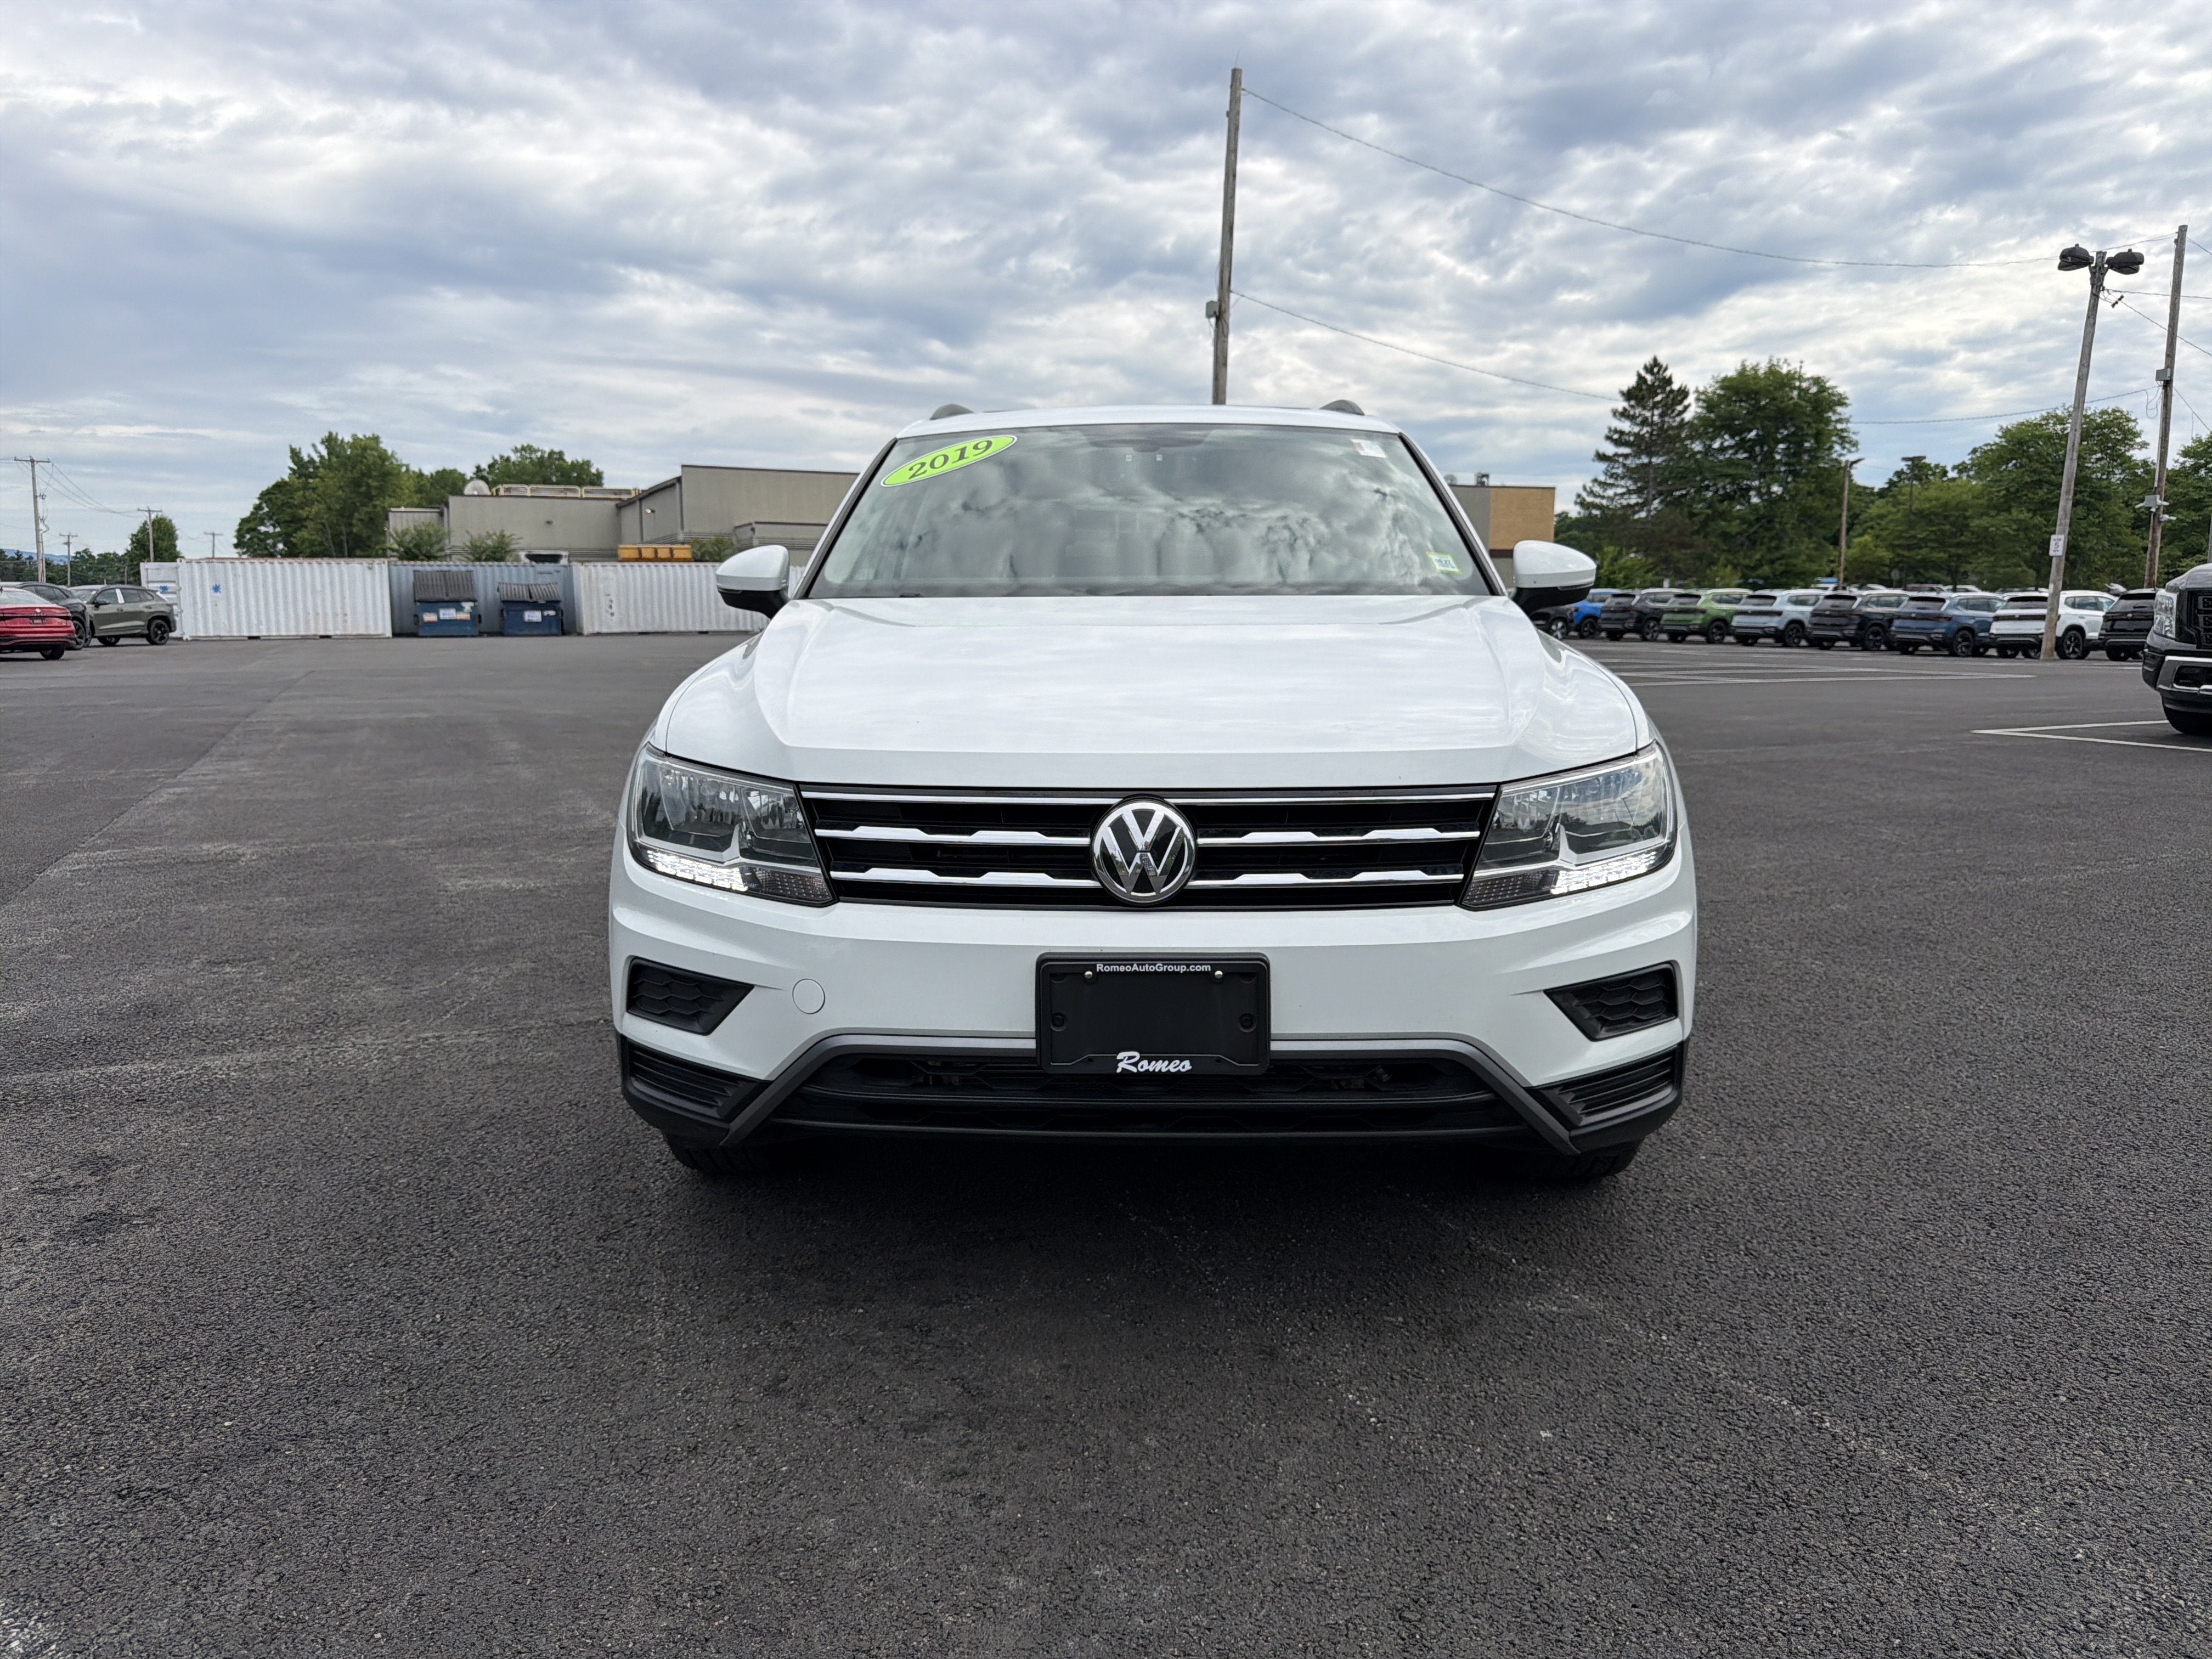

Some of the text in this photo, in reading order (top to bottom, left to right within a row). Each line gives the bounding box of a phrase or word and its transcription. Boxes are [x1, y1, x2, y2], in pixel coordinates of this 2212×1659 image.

[908, 439, 993, 479] 2019
[1096, 805, 1190, 896] VW
[1096, 963, 1211, 974] RomeoAutoGroup.com
[1116, 1051, 1192, 1073] Romeo
